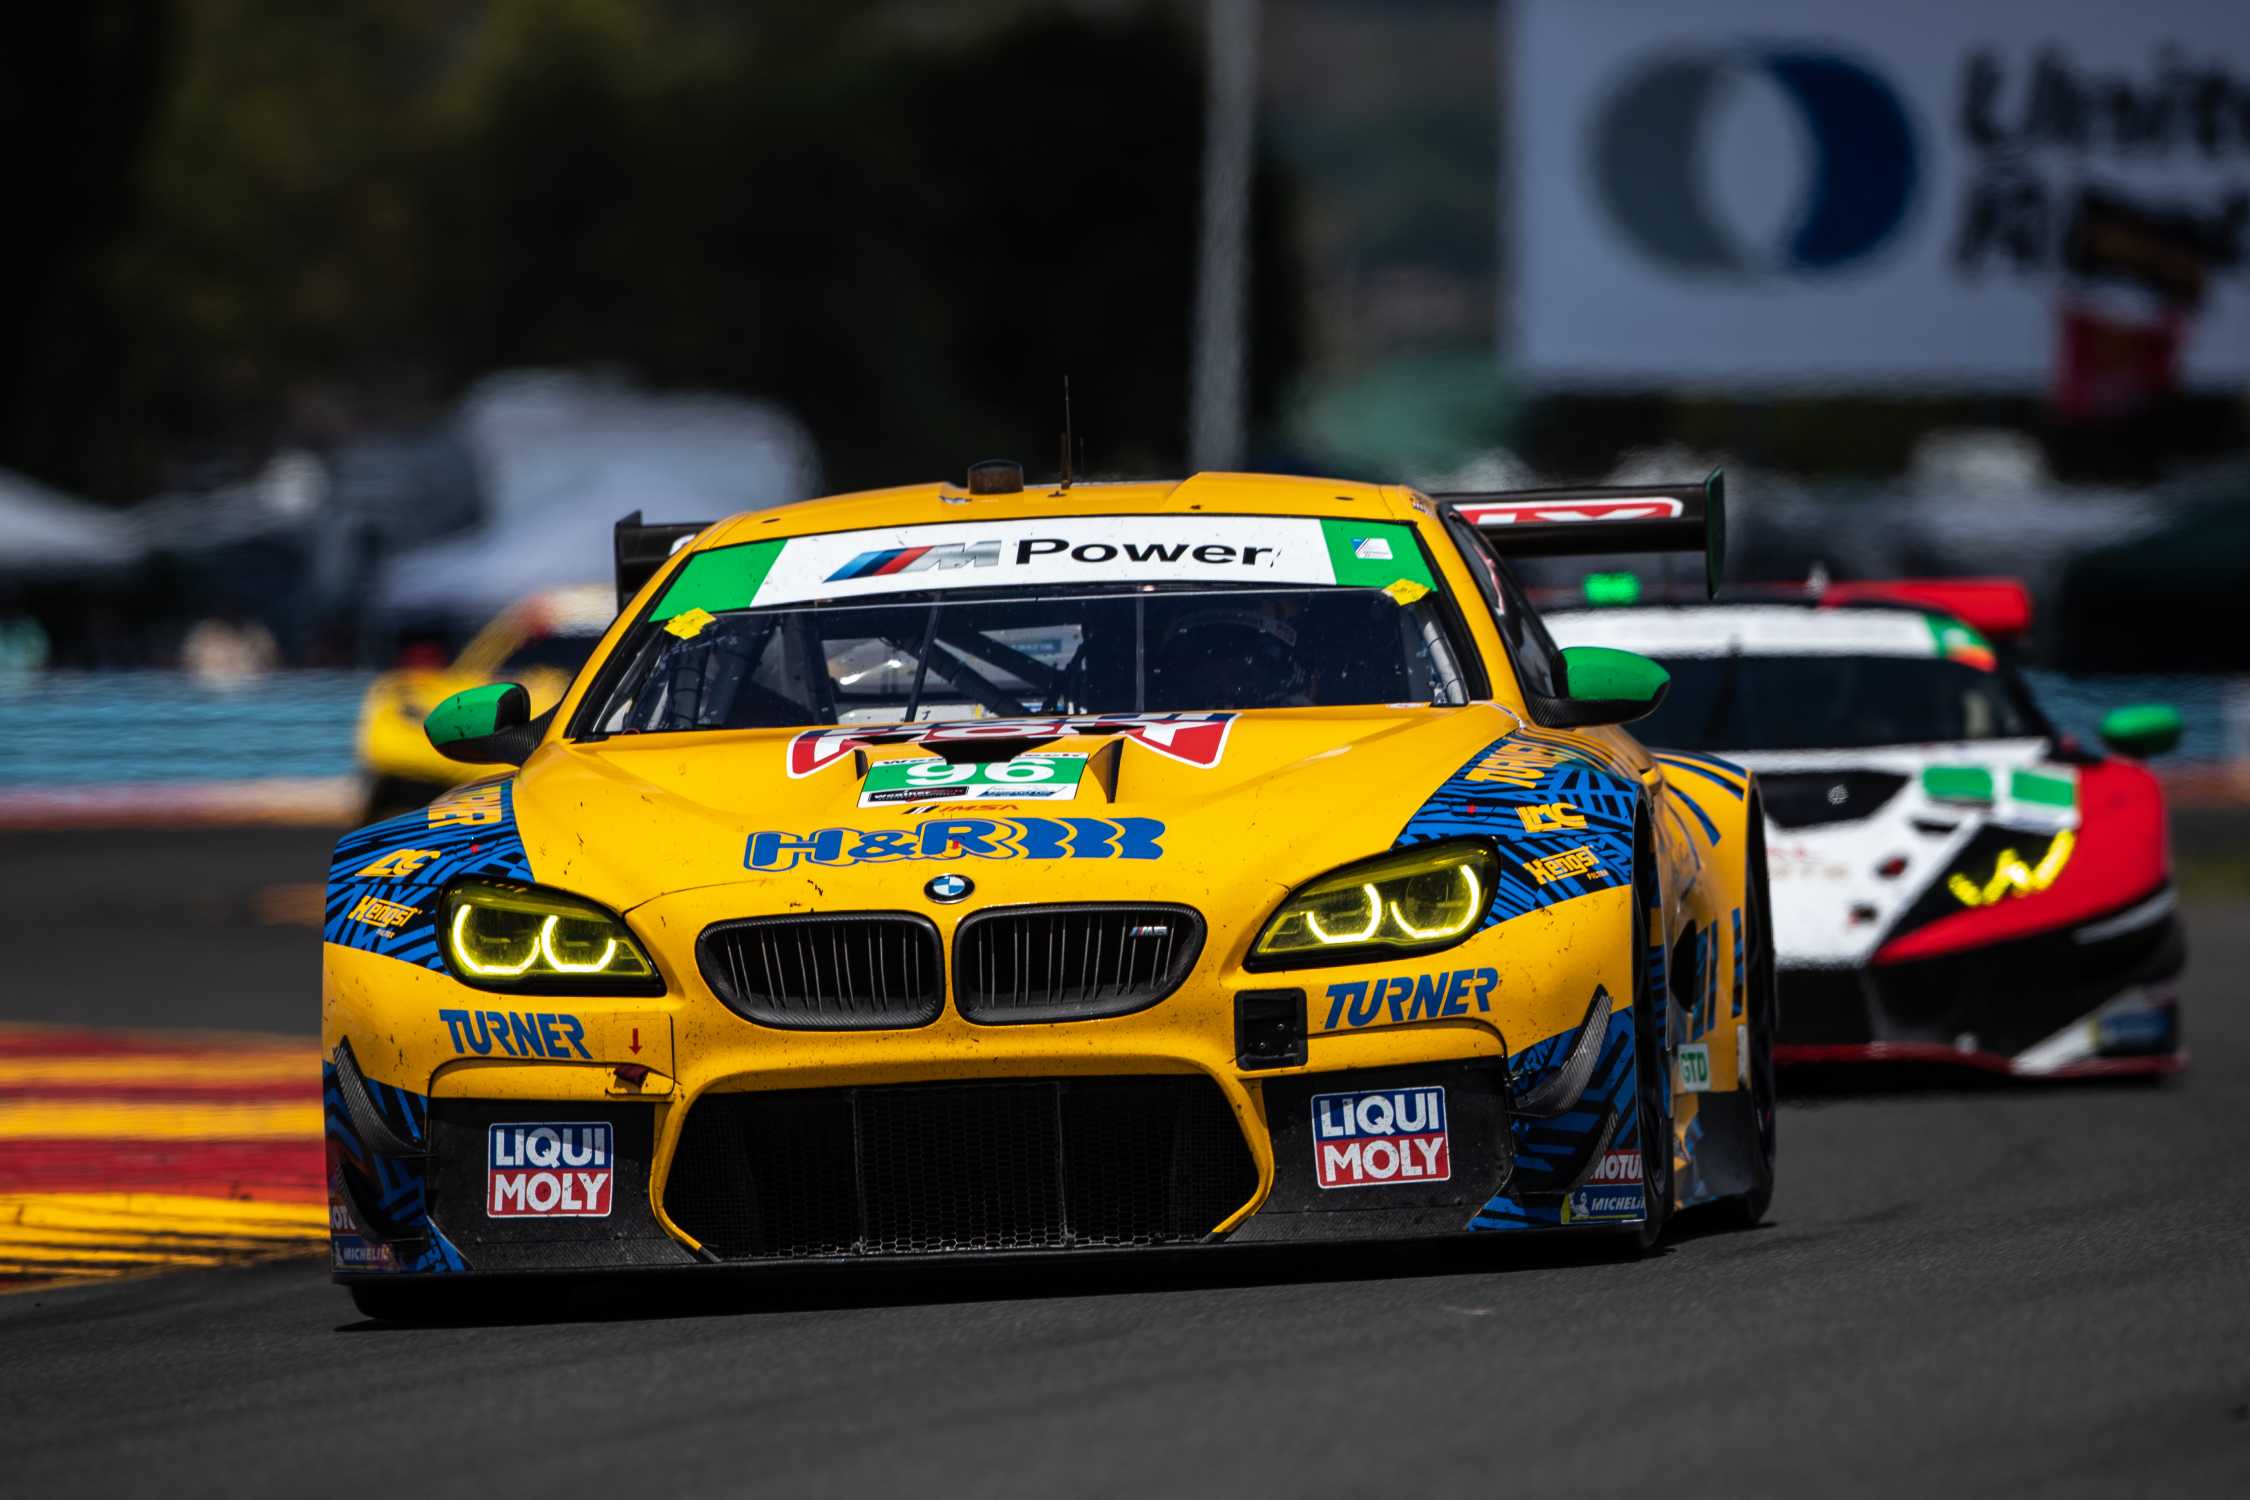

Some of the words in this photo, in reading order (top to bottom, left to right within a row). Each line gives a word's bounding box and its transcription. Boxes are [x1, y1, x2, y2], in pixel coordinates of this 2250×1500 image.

[1015, 538, 1273, 566] Power
[905, 758, 1056, 785] 96
[939, 803, 1019, 813] IMSA
[743, 818, 1018, 870] H&R
[1325, 967, 1499, 1029] TURNER
[439, 1009, 593, 1060] TURNER
[1320, 1092, 1440, 1137] LIQUI
[495, 1127, 605, 1169] LIQUI
[1323, 1136, 1445, 1183] MOLY
[494, 1172, 608, 1212] MOLY
